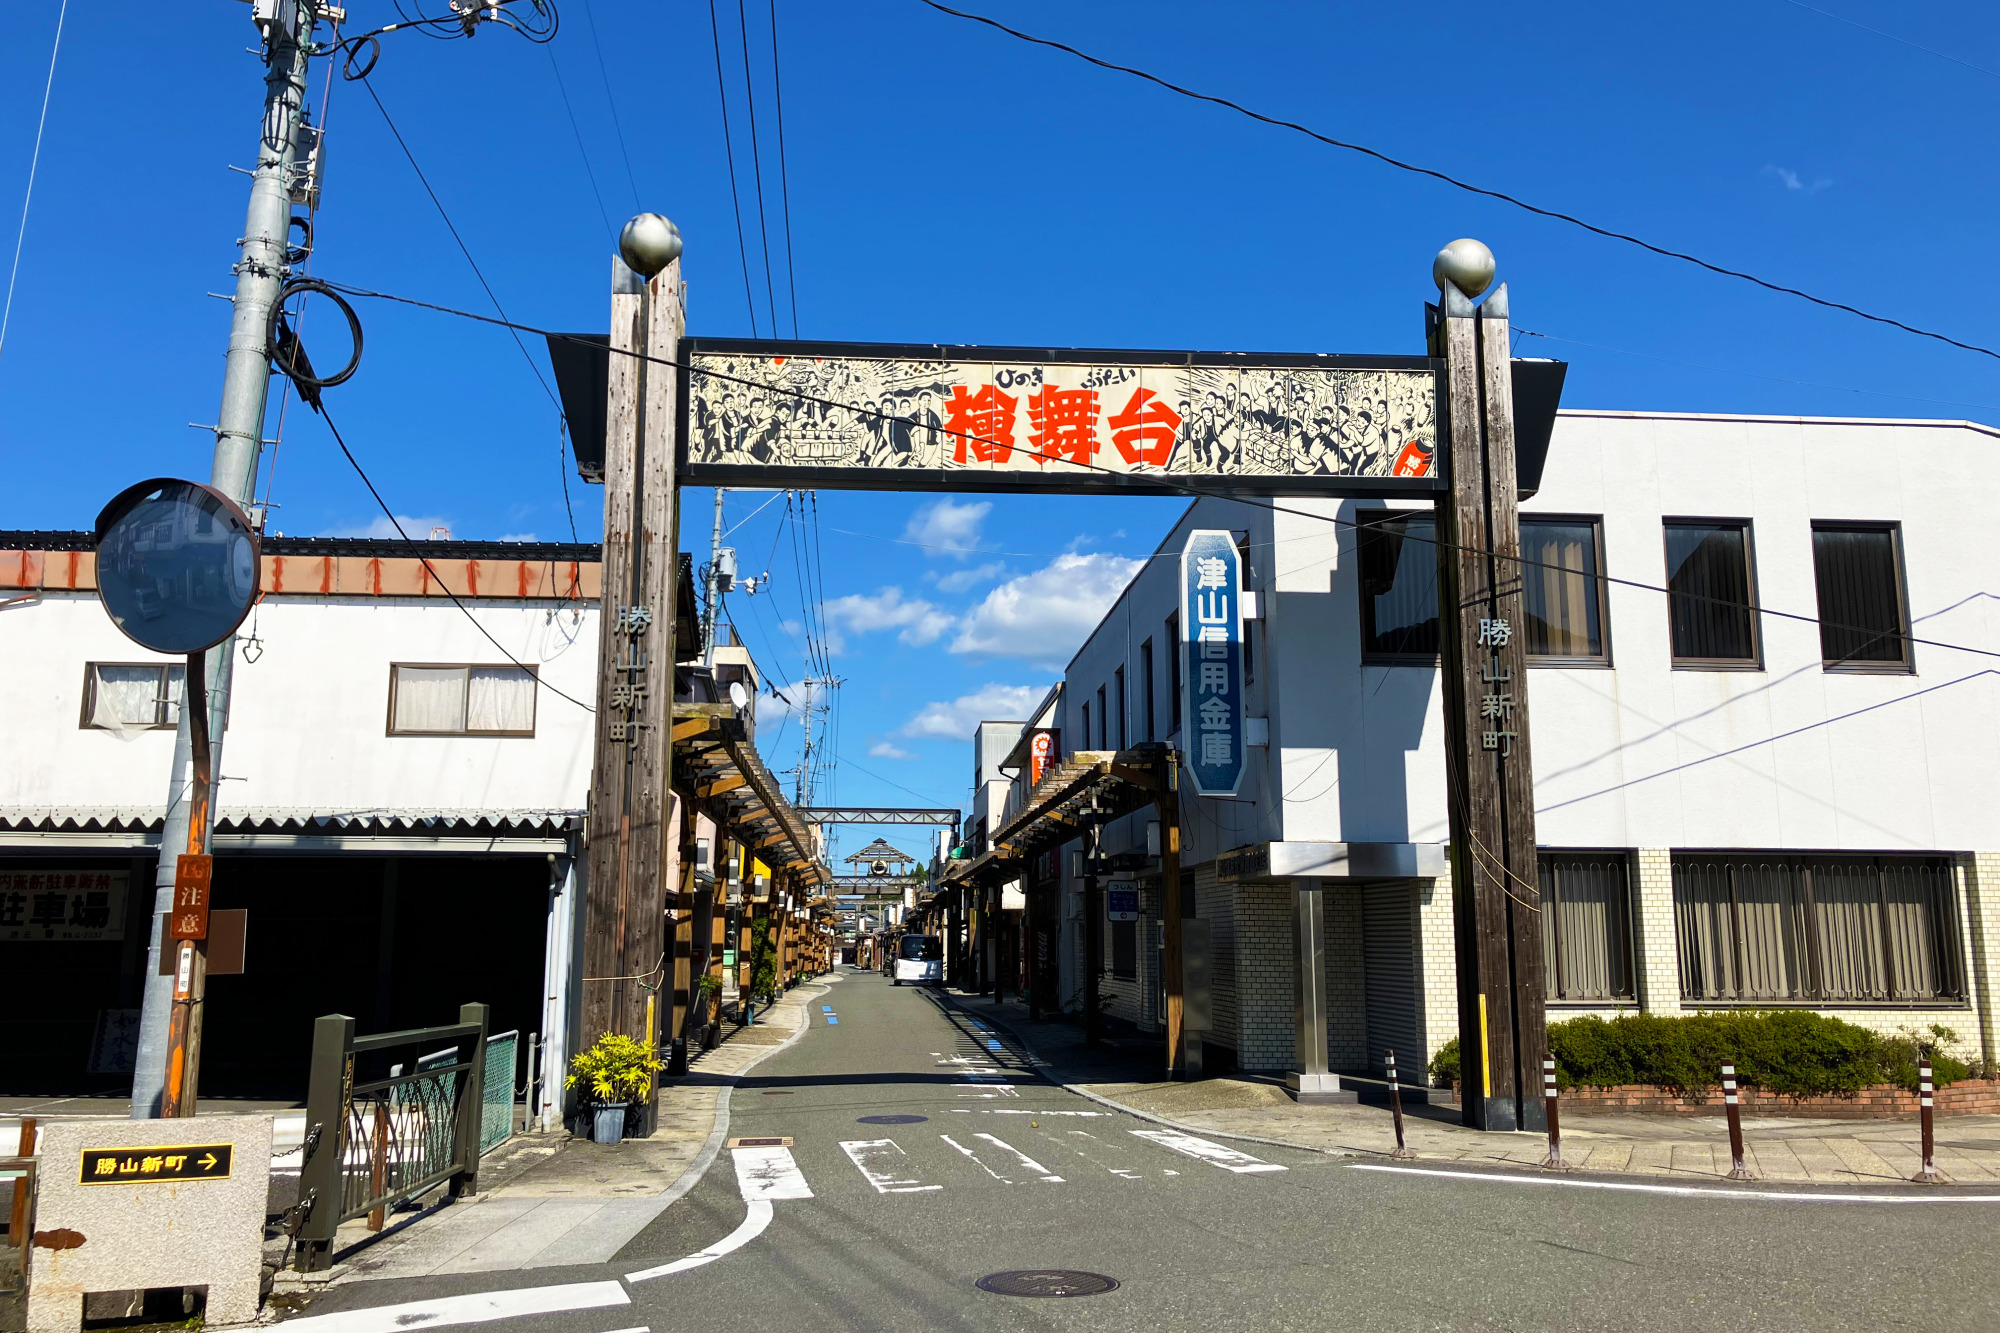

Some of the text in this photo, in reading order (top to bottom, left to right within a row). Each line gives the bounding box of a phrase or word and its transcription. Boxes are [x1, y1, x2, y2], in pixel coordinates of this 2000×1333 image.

[995, 366, 1136, 389] ひのき ぶたい
[943, 383, 1183, 467] 檜舞台
[610, 605, 653, 749] 勝山新町
[1196, 556, 1233, 768] 津山信用金庫
[1477, 618, 1518, 758] 勝山新町
[178, 886, 203, 933] 注意
[94, 1155, 188, 1175] 勝山新町
